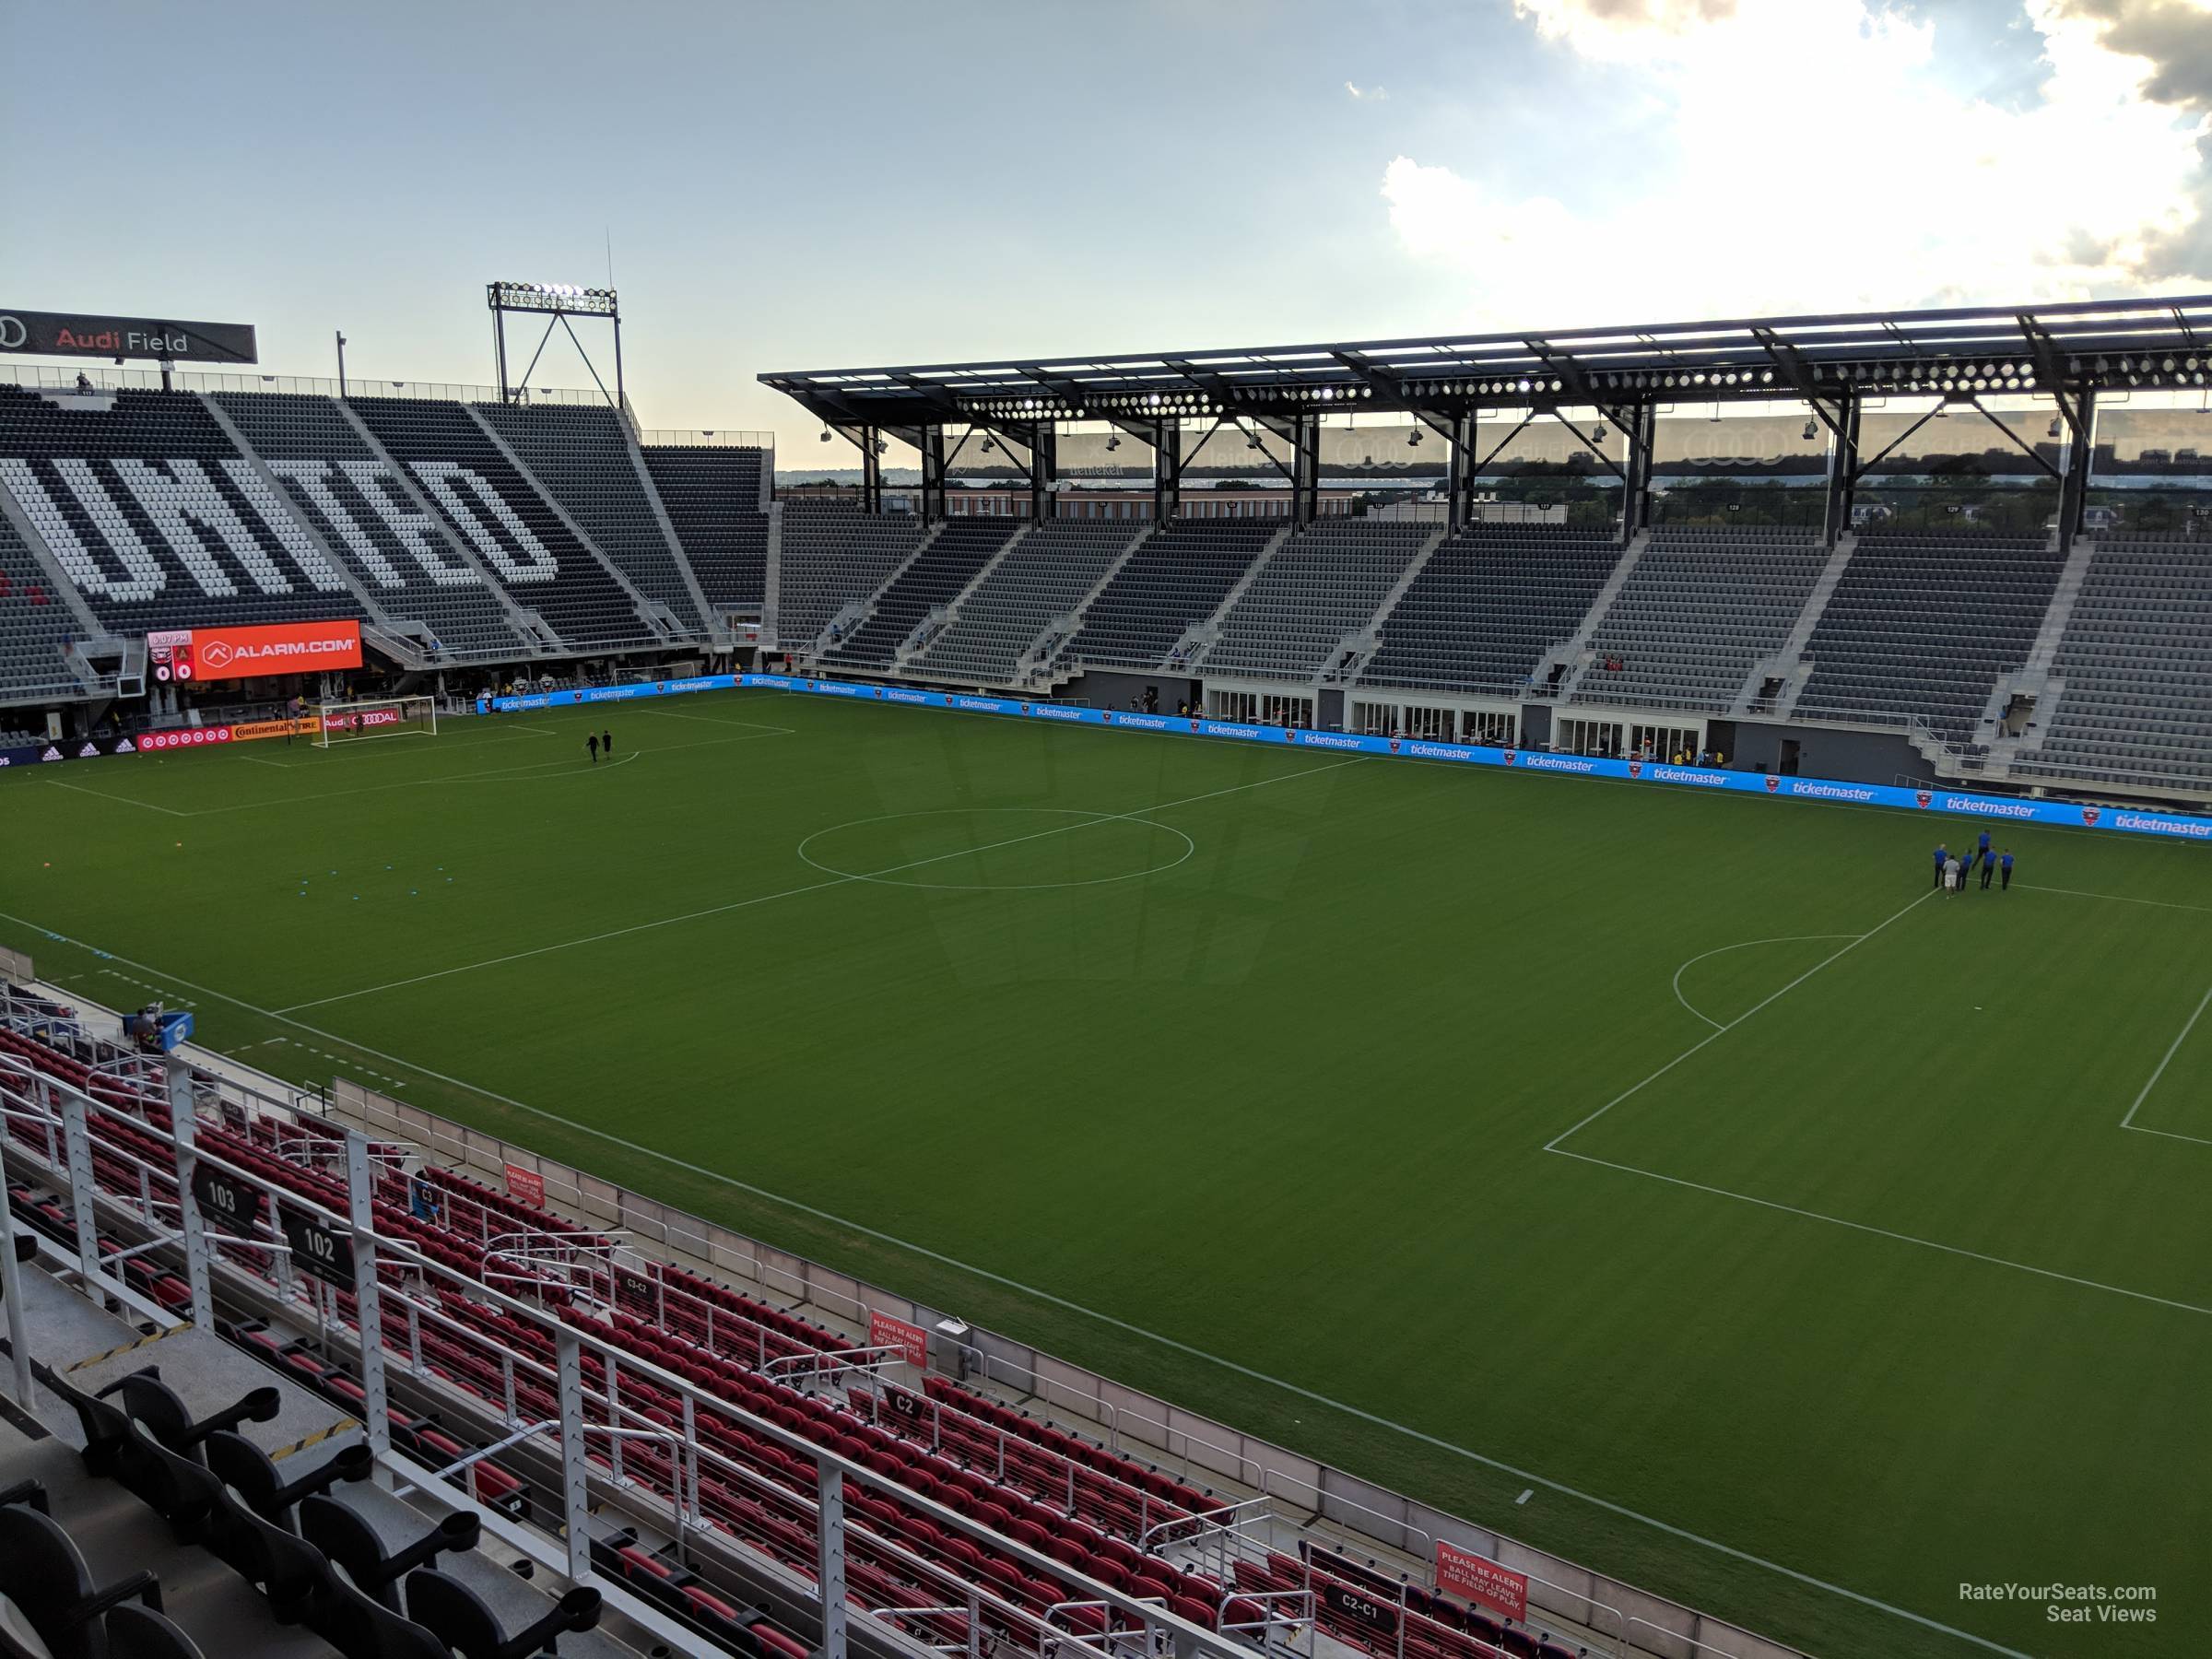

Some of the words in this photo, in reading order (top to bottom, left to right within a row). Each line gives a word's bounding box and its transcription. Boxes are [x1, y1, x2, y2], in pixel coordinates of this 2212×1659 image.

[56, 328, 120, 349] Audi
[127, 332, 188, 352] Field
[0, 459, 559, 602] UNITED
[235, 640, 355, 659] ALARM.COM
[157, 665, 171, 681] 0
[178, 664, 192, 679] 0
[671, 680, 713, 691] ticketmaster
[751, 677, 790, 688] ticketmaster
[819, 684, 856, 695] ticketmaster
[590, 688, 635, 700] ticketmaster
[888, 691, 926, 702] ticketmaster
[959, 699, 1001, 711] ticketmaster
[1037, 707, 1081, 720] ticketmaster
[1119, 714, 1167, 729] ticketmaster
[235, 723, 288, 738] Continental
[1208, 724, 1259, 738] ticketmaster
[1305, 734, 1361, 749] ticketmaster
[1410, 744, 1473, 760] ticketmaster
[1526, 755, 1594, 772] ticketmaster
[1653, 767, 1727, 785] ticketmaster
[1793, 781, 1874, 801] ticketmaster
[1947, 796, 2035, 818] ticketmaster
[2115, 814, 2211, 836] ticketmaster
[209, 1181, 236, 1213] 103
[421, 1189, 433, 1203] C3
[305, 1228, 335, 1263] 102
[628, 1277, 647, 1293] C3-C2
[874, 1319, 897, 1333] PLEASE
[897, 1327, 905, 1336] BE
[874, 1335, 885, 1344] THE
[877, 1330, 891, 1340] BALL
[891, 1335, 904, 1345] MAY
[903, 1340, 920, 1351] LEAVE
[896, 1394, 913, 1414] C2
[1441, 1551, 1476, 1571] PLEASE
[1477, 1567, 1490, 1579] BE
[1443, 1570, 1461, 1583] THE
[1461, 1577, 1485, 1593] FIELD
[1486, 1588, 1499, 1598] OF
[1449, 1565, 1470, 1579] BALL
[1470, 1574, 1489, 1586] MAY
[1490, 1583, 1516, 1600] LEAVE
[1342, 1594, 1378, 1619] C2-C1
